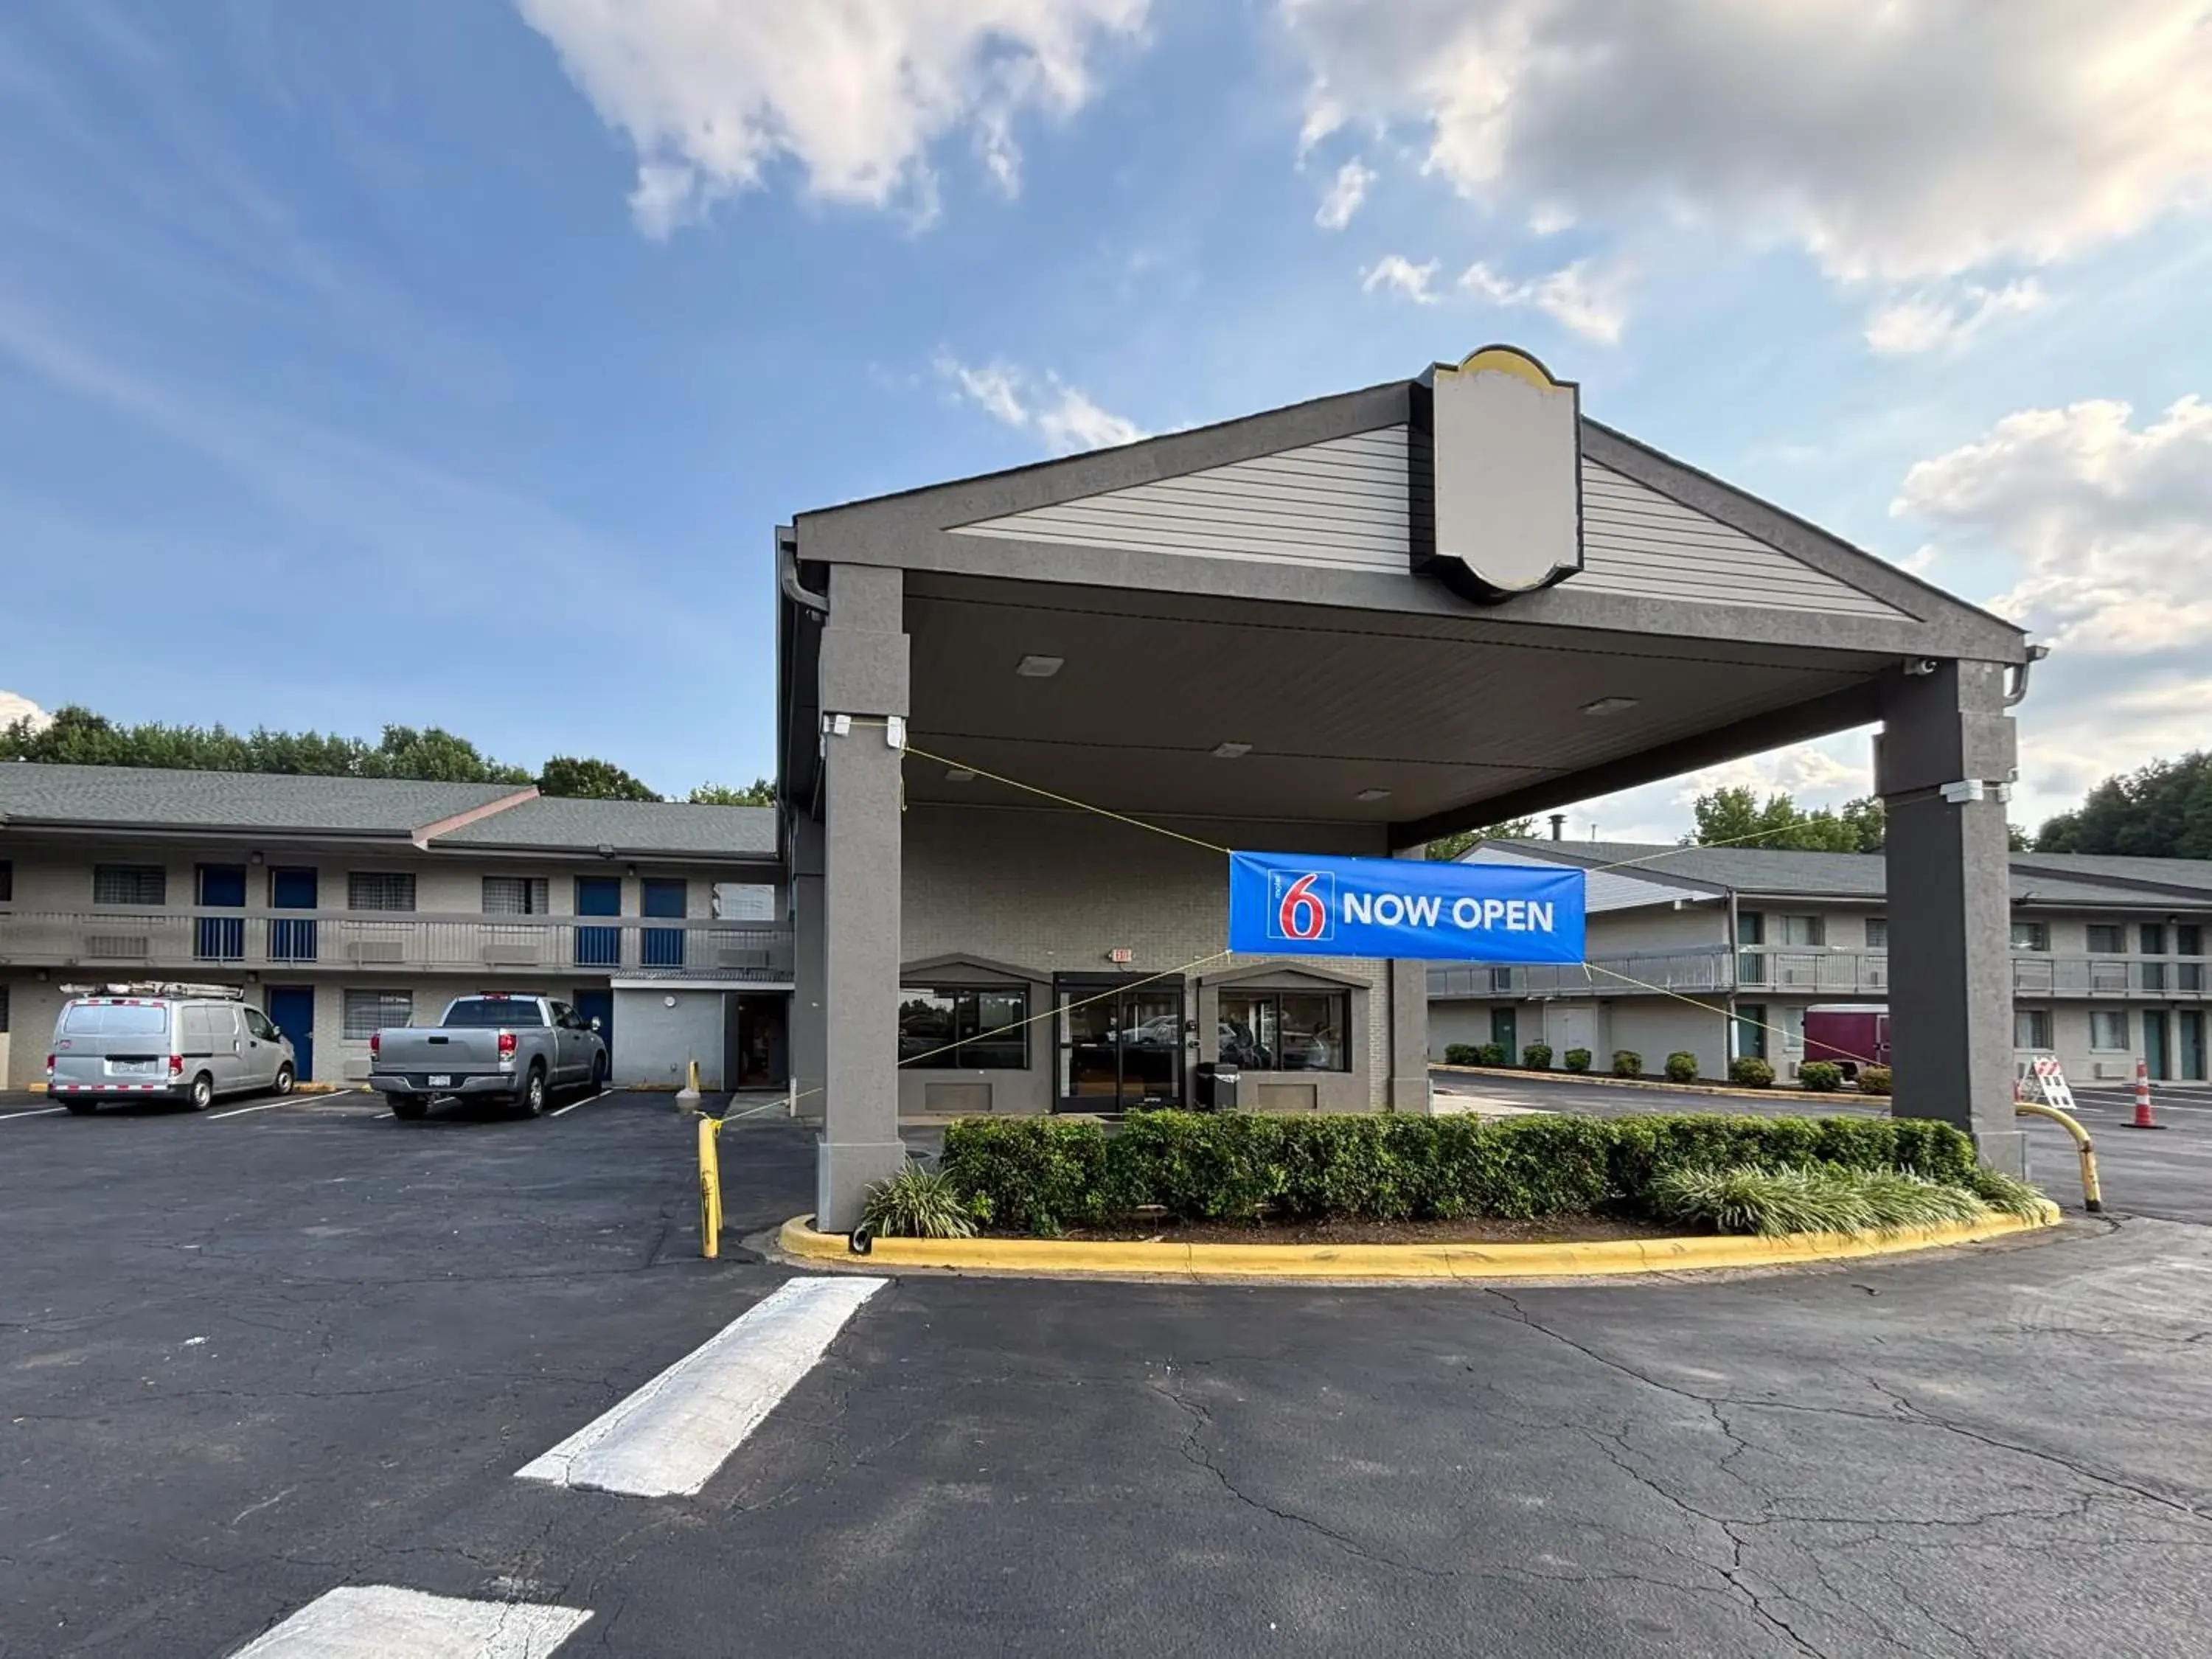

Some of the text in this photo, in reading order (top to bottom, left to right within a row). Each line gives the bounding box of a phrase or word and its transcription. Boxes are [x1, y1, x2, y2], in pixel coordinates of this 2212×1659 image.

[1279, 873, 1326, 940] 6
[1343, 892, 1554, 932] NOW OPEN
